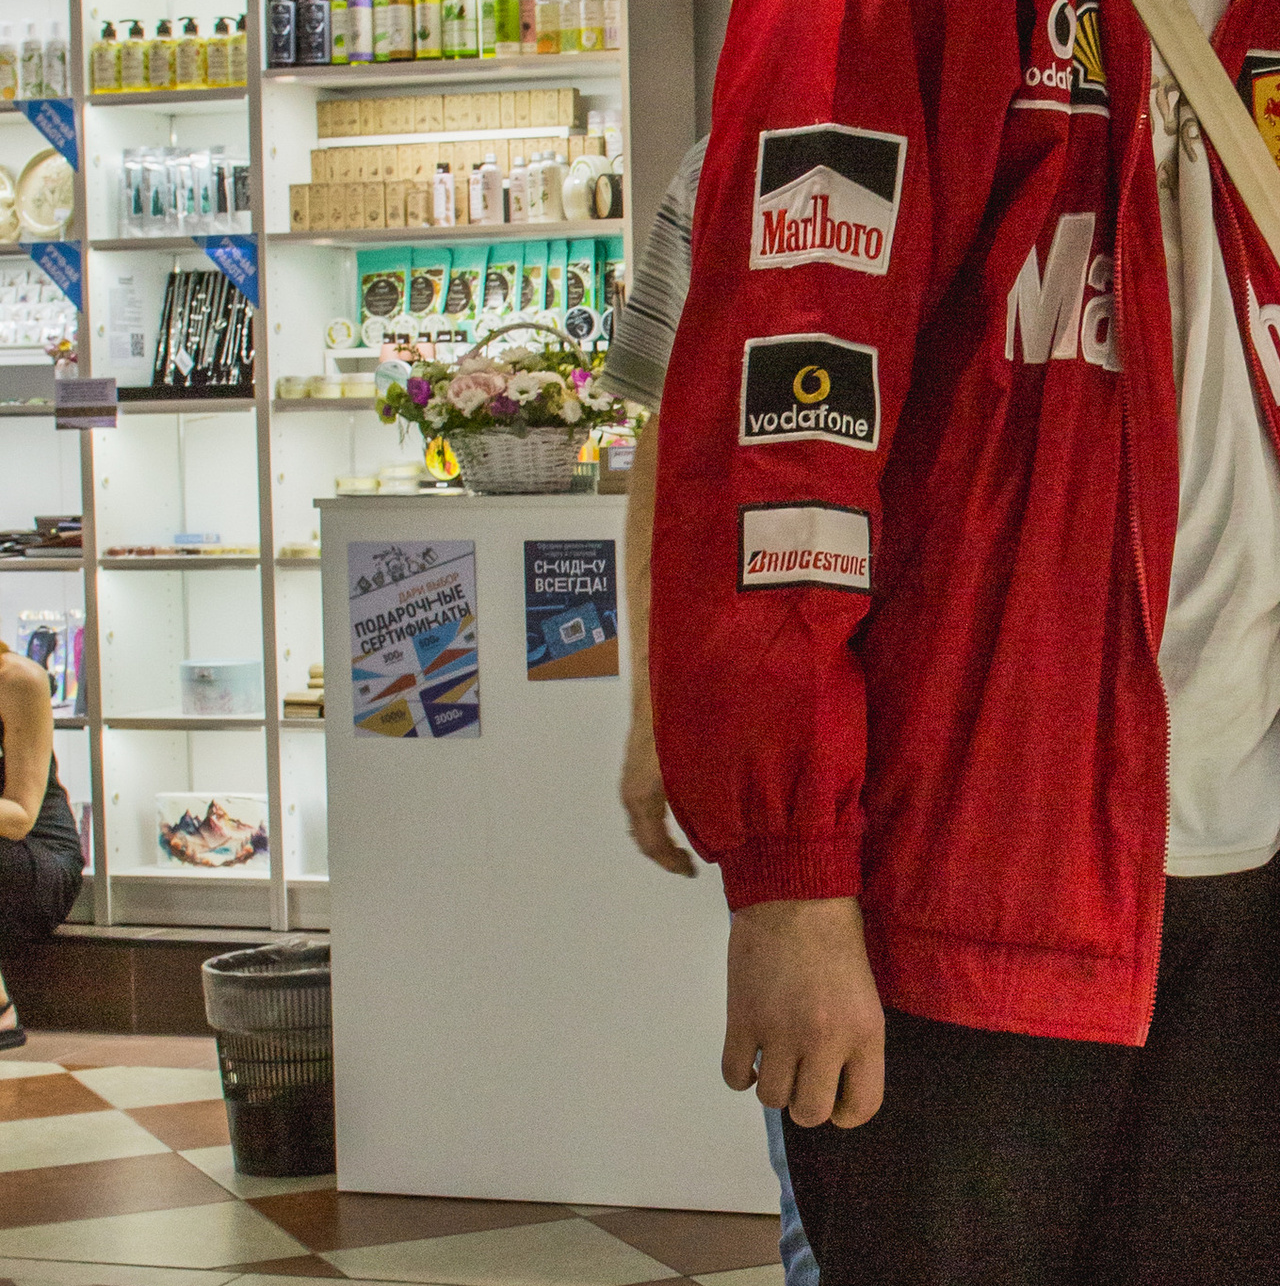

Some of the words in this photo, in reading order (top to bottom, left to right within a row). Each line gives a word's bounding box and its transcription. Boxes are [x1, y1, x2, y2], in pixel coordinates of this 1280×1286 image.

[760, 194, 884, 261] Marlboro
[749, 404, 868, 437] vodafone
[534, 559, 606, 576] СКИДКУ
[747, 549, 867, 576] BRIDGESTONE
[535, 576, 608, 595] ВСЕГДА!
[354, 583, 466, 638] ПОДАРОЧНЫЕ
[360, 602, 472, 654] СЕРТИФИКАТЫ
